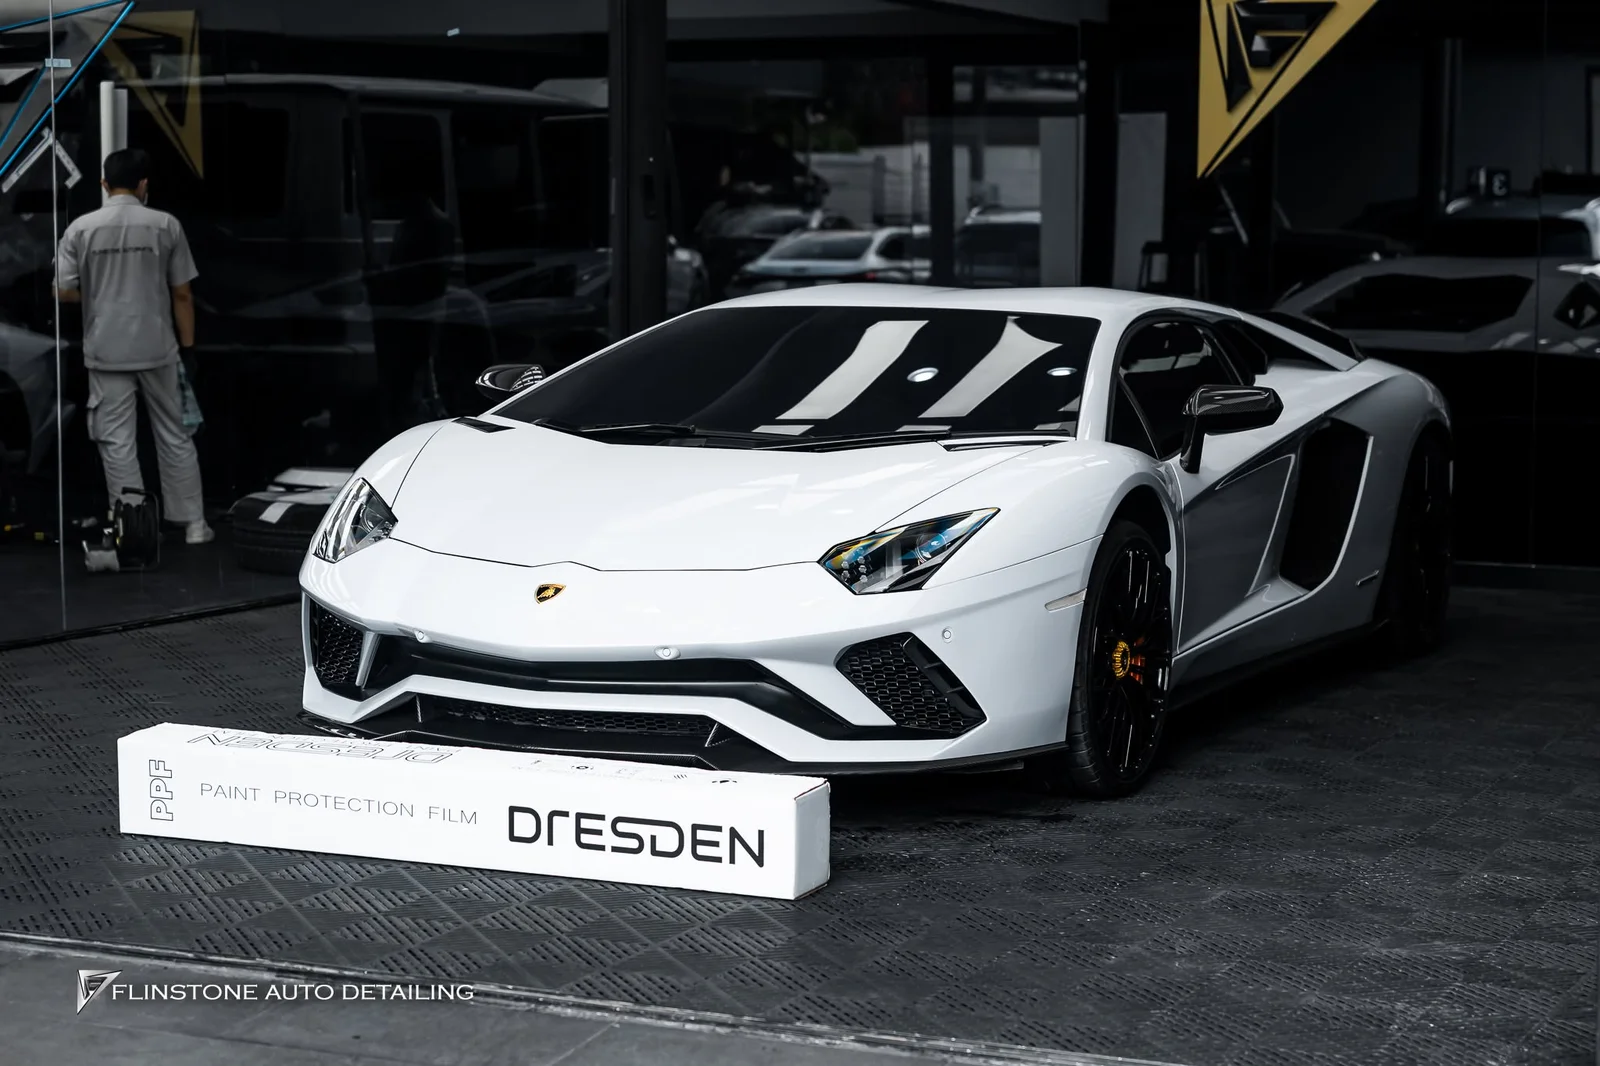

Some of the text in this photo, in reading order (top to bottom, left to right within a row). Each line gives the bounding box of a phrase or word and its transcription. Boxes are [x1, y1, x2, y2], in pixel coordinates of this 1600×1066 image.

[149, 759, 174, 822] PPF
[200, 783, 478, 825] PAINT PROTECTION FILM
